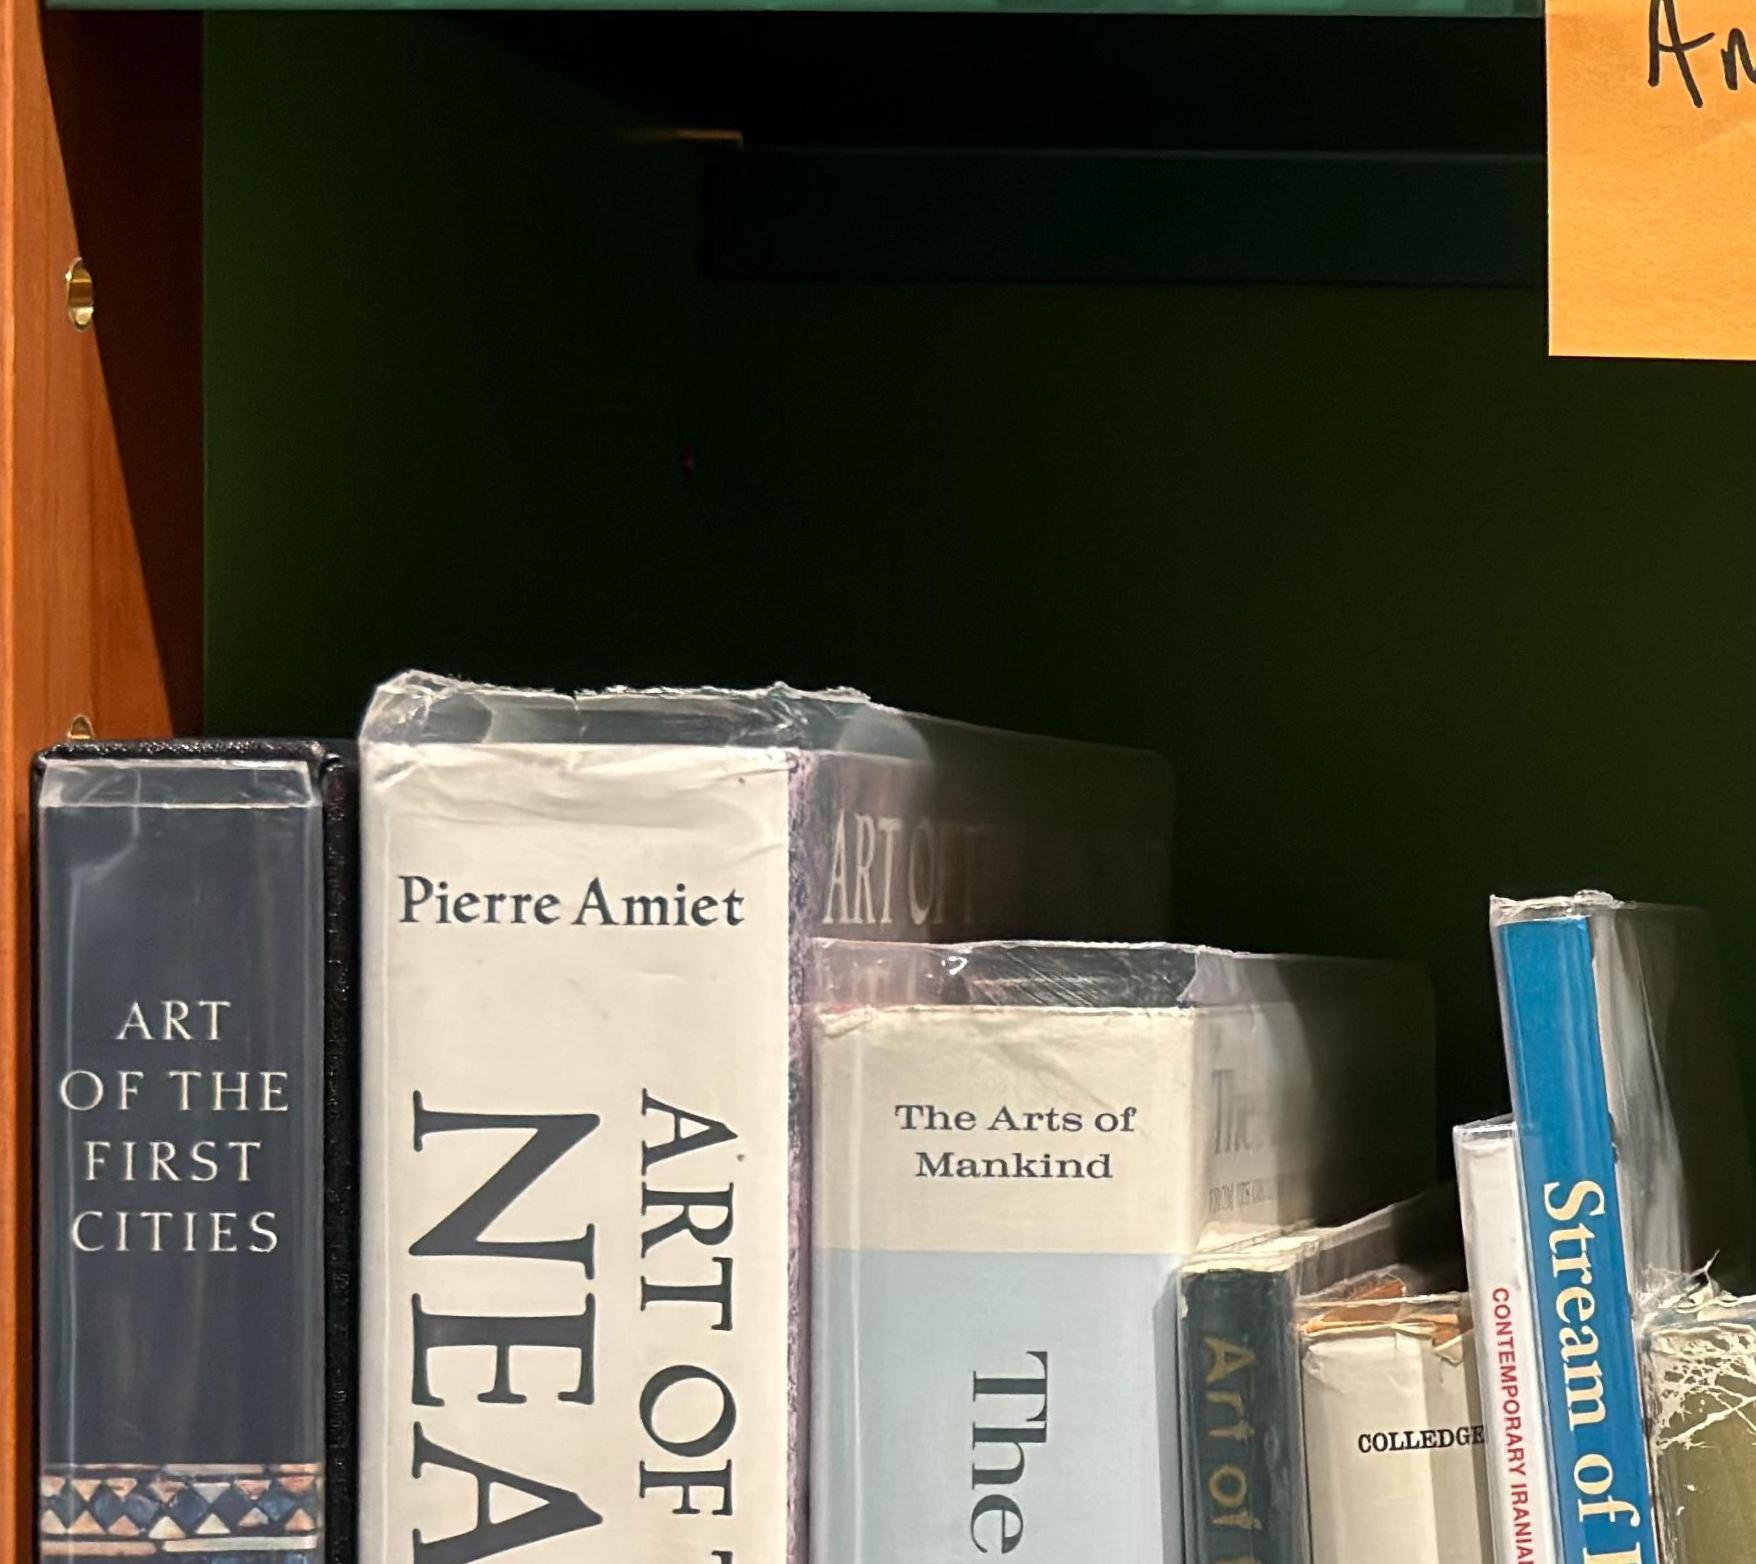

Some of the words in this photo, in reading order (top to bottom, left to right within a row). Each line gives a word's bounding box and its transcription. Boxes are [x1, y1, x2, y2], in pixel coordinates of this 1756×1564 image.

[822, 807, 902, 925] ART
[398, 875, 561, 926] Pierre
[571, 876, 745, 926] Amiet
[115, 1000, 231, 1041] ART
[59, 1069, 145, 1113] OF
[168, 1069, 290, 1113] THE
[895, 1104, 977, 1132] The
[986, 1104, 1083, 1132] Arts
[1093, 1105, 1138, 1133] of
[83, 1141, 262, 1183] FIRST
[914, 1151, 1113, 1180] Mankind
[71, 1210, 280, 1254] CITIES
[638, 1087, 739, 1332] ART
[1543, 1180, 1607, 1432] Stream
[1203, 1334, 1256, 1441] Art
[1491, 1287, 1528, 1475] CONTEMPORARY
[636, 1363, 738, 1518] OF
[970, 1350, 1048, 1556] The
[1357, 1424, 1486, 1454] COLLEDGE
[1208, 1465, 1262, 1531] of
[1573, 1450, 1640, 1530] of
